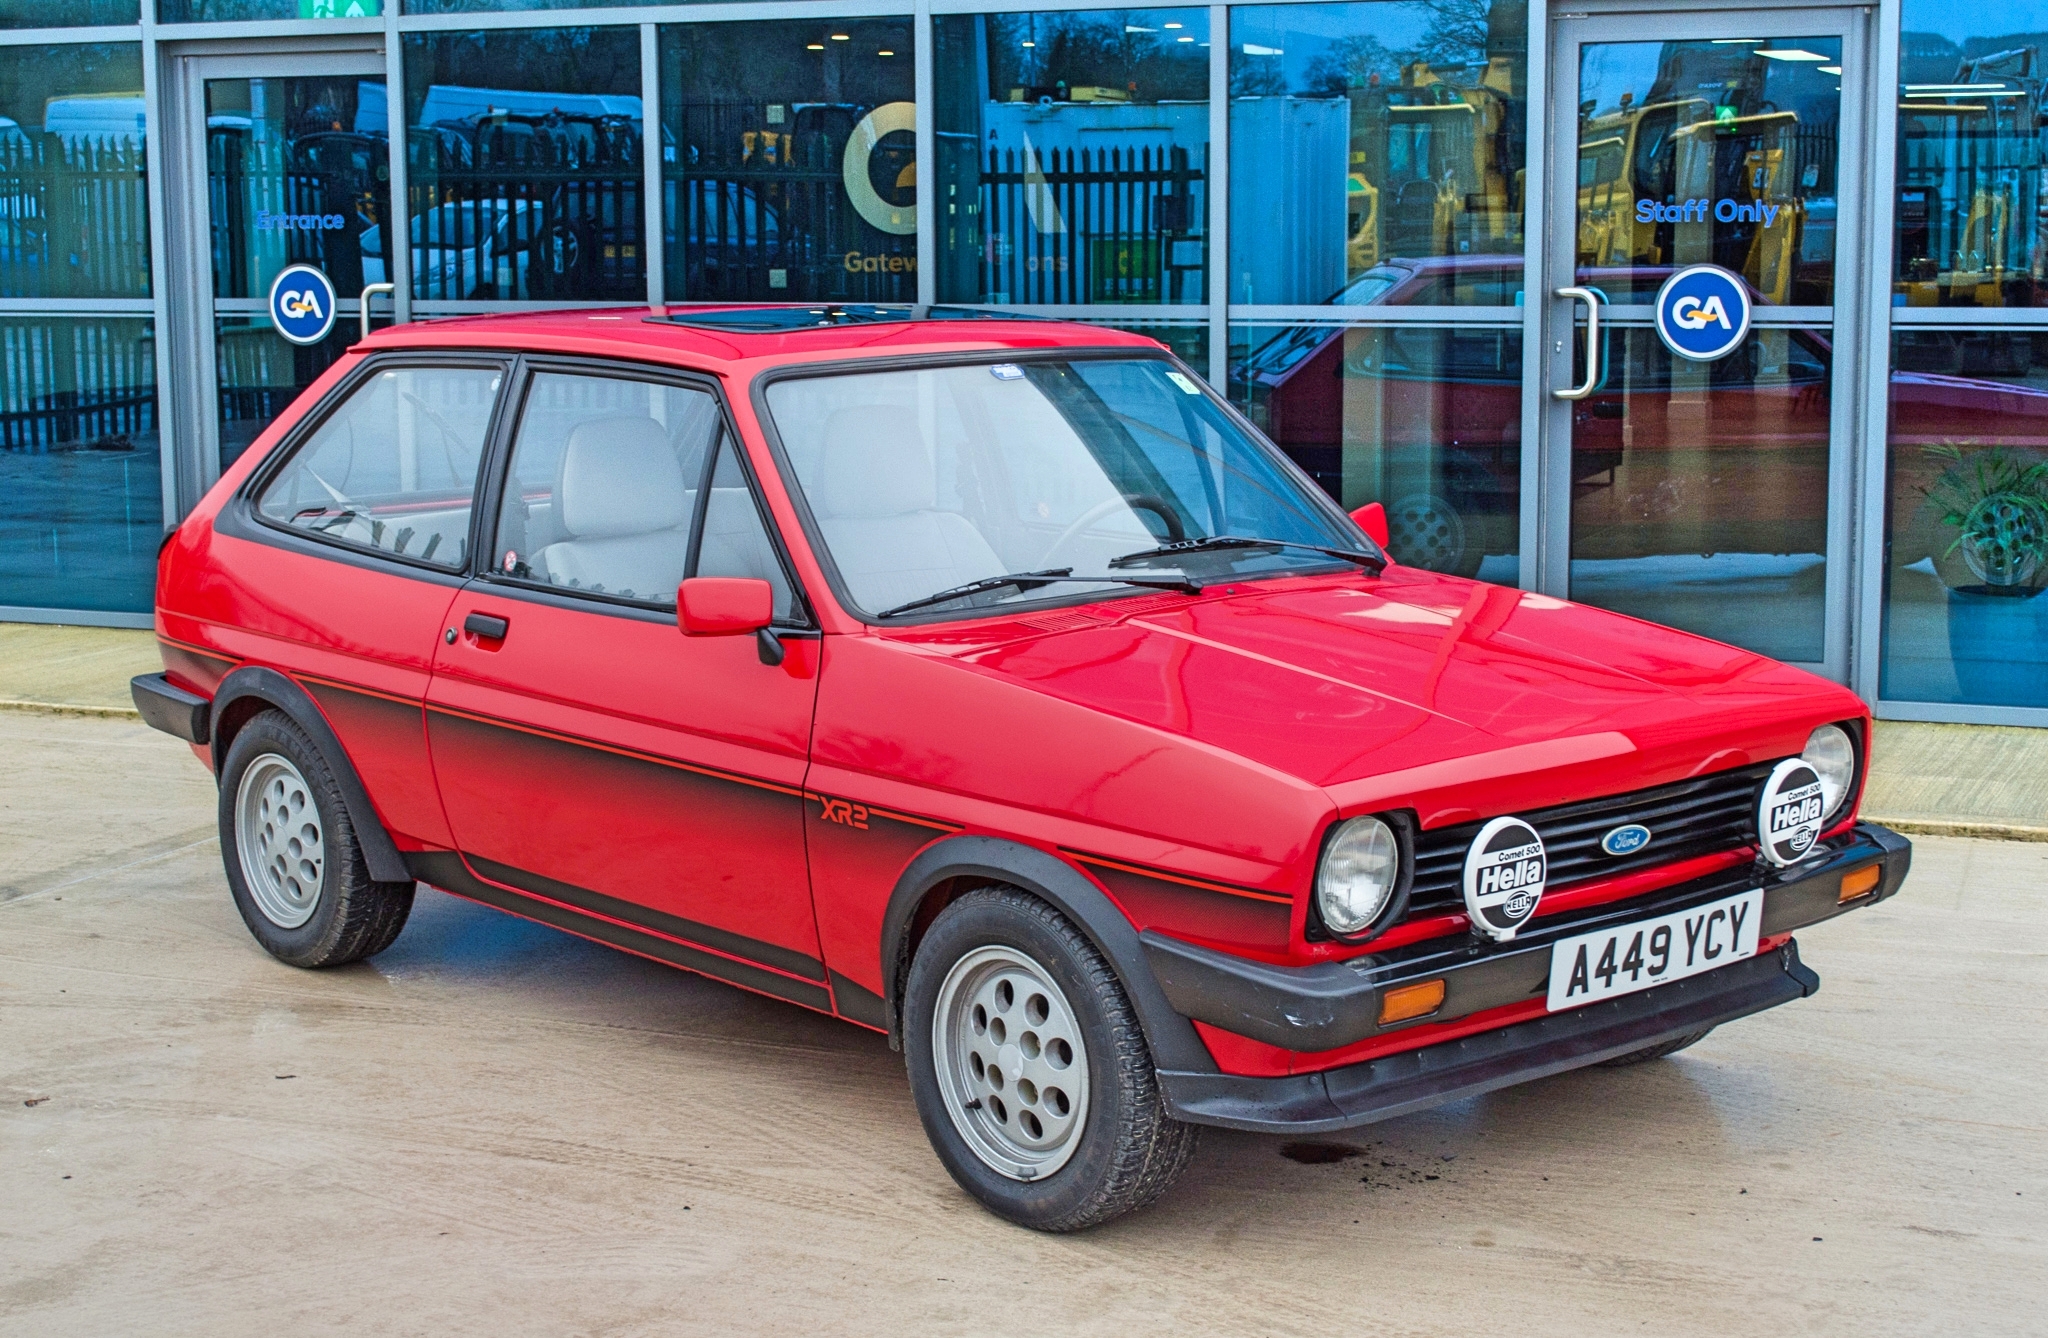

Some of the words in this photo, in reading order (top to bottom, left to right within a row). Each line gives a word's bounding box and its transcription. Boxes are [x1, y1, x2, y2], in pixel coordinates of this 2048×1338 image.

[257, 209, 345, 230] Entrance
[1635, 198, 1710, 223] Staff
[1714, 198, 1780, 228] Only
[280, 289, 324, 319] GA
[1672, 295, 1732, 330] GA
[1787, 789, 1809, 801] Comet
[1809, 783, 1821, 794] 500
[820, 796, 869, 830] XR2
[1772, 797, 1821, 831] Hella
[1498, 848, 1525, 861] Comet
[1526, 844, 1541, 856] 500
[1614, 831, 1641, 849] Ford
[1479, 859, 1542, 894] Hella
[1505, 894, 1532, 909] HELLA
[1565, 924, 1672, 998] A449
[1684, 900, 1750, 967] YCY
